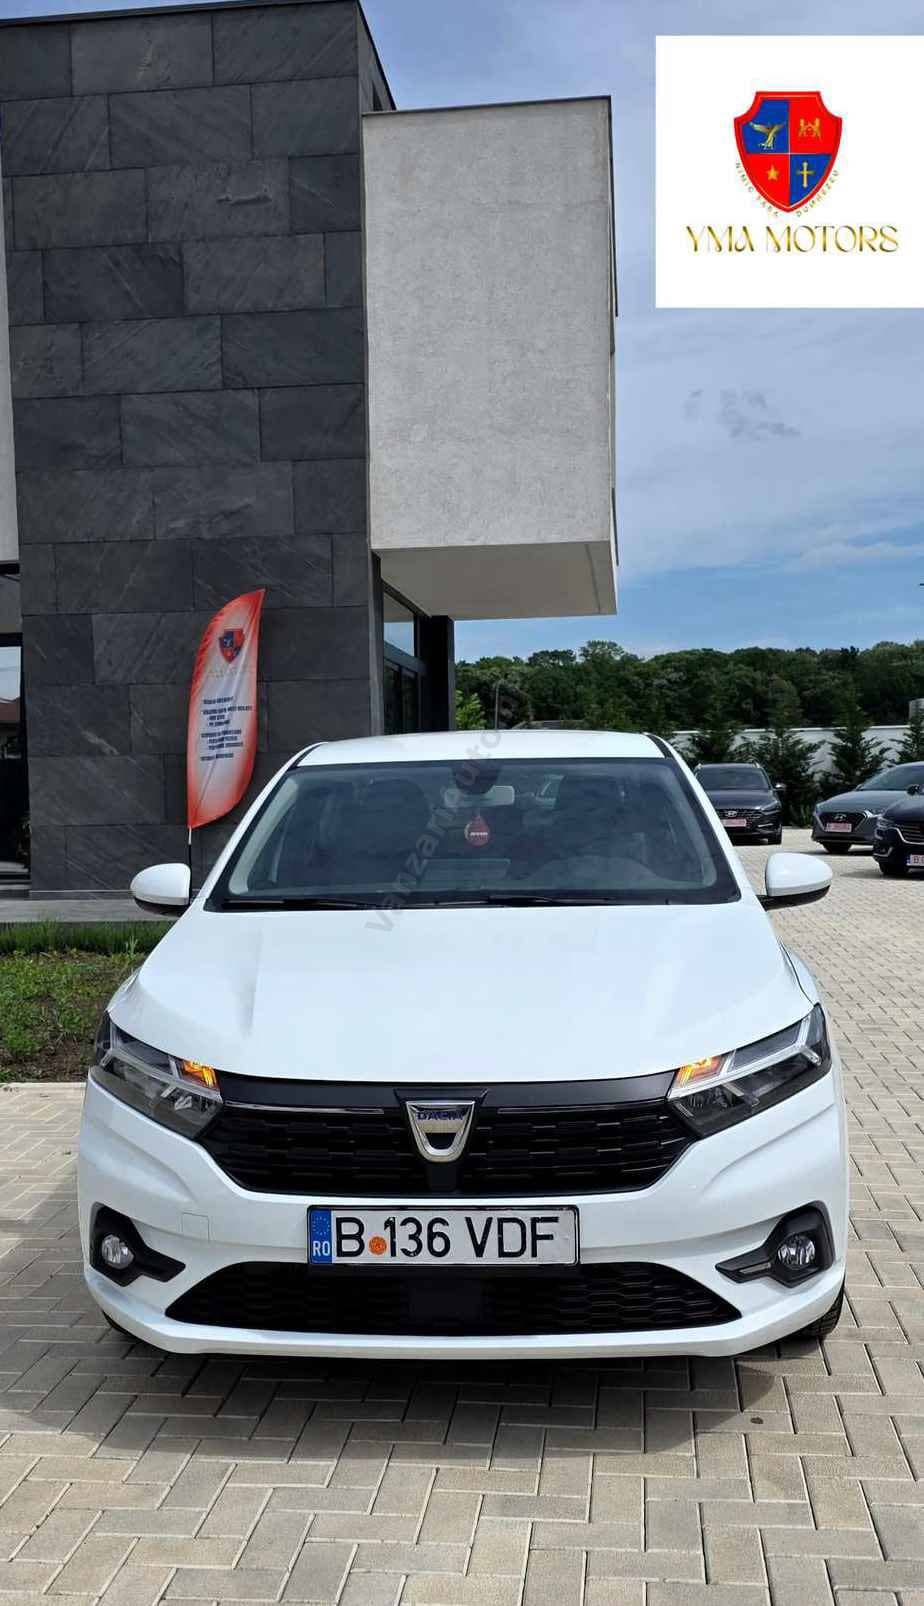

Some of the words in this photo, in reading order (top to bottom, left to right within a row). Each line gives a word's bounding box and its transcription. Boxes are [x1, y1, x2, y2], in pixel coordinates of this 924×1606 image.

[312, 1240, 331, 1257] RO
[335, 1216, 365, 1258] B
[384, 1216, 450, 1258] 136
[464, 1216, 560, 1258] VDF
